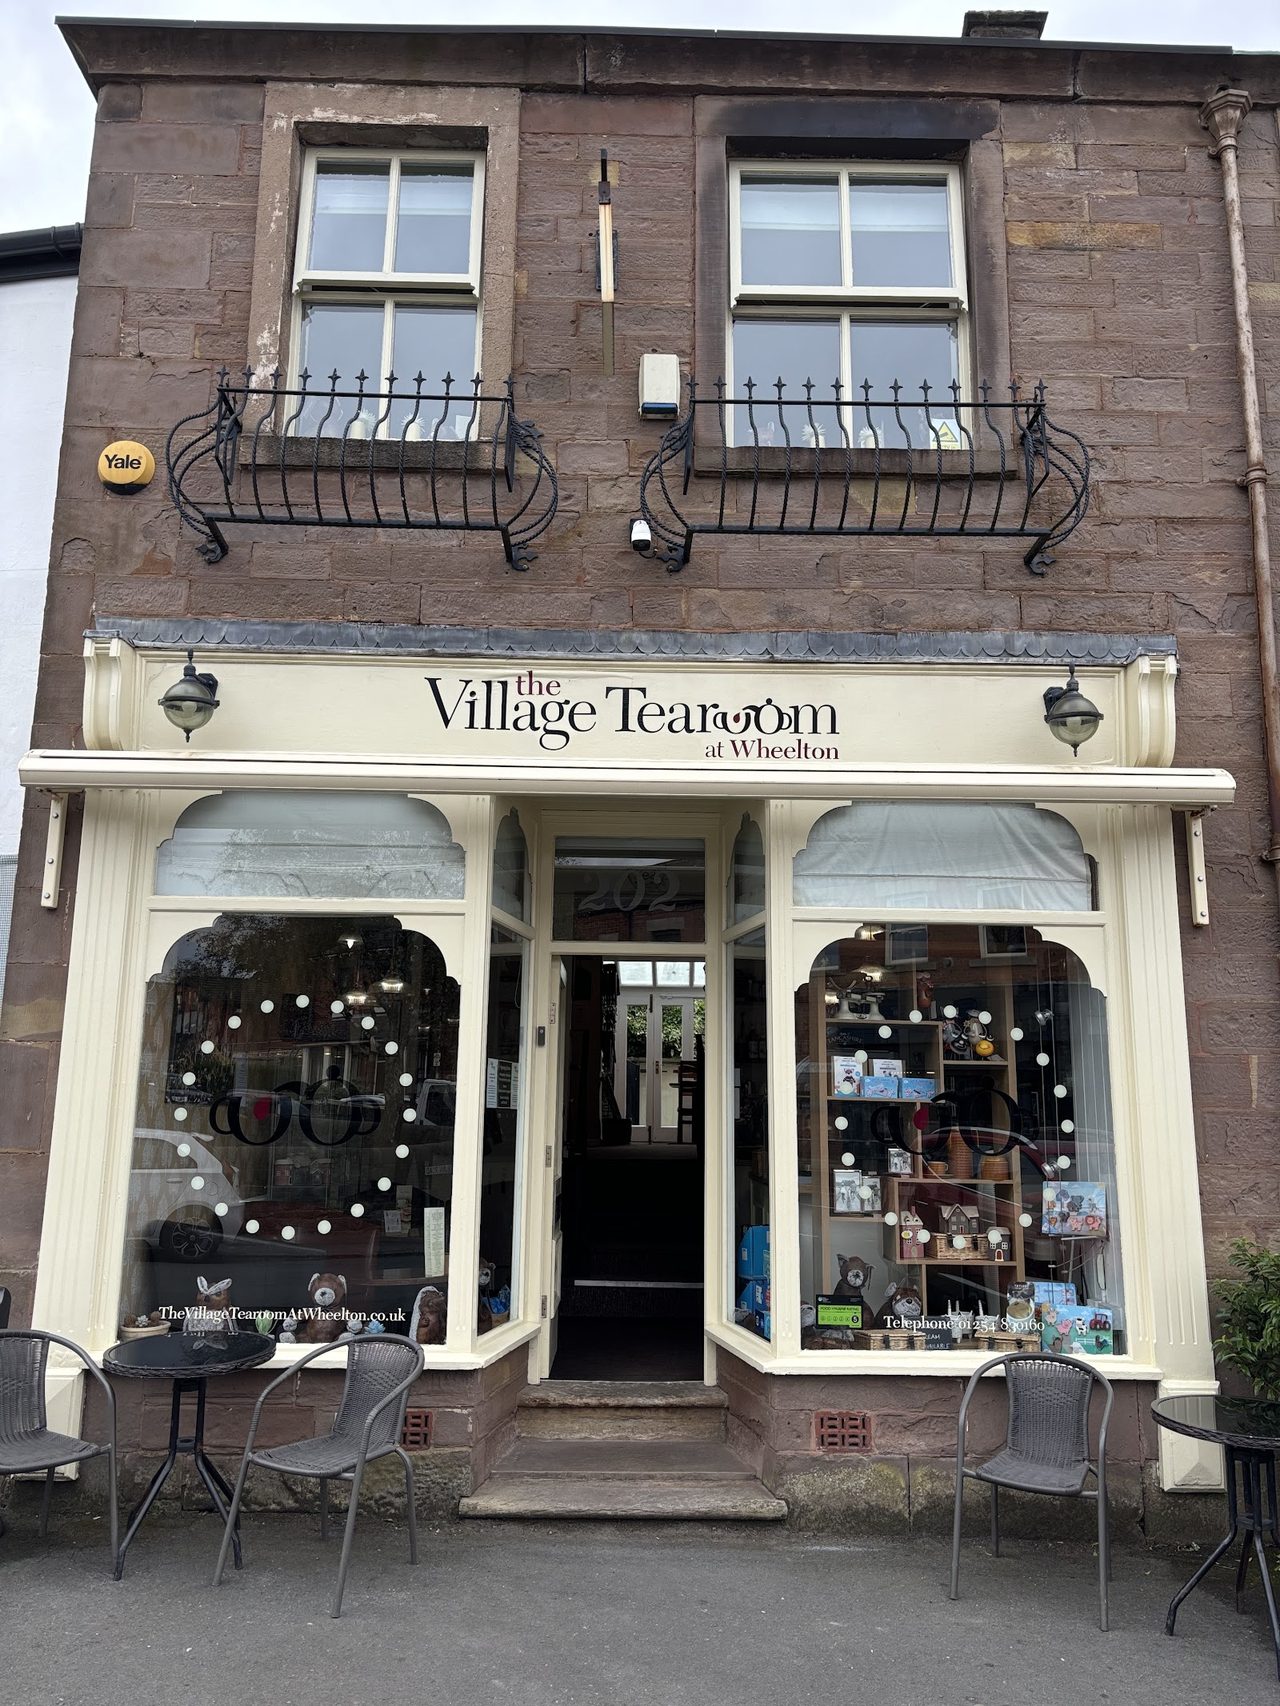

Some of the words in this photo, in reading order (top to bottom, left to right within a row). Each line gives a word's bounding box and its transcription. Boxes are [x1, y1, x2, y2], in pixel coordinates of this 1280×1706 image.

[104, 454, 142, 470] Yale
[515, 670, 561, 696] the
[424, 677, 597, 751] Village
[605, 686, 840, 735] Tearoom
[705, 741, 724, 759] at
[730, 739, 840, 760] Wheelton
[578, 869, 680, 912] 202
[158, 1305, 406, 1323] TheVillageTearoomAtWheelton.co.uk
[883, 1315, 955, 1332] Telephone
[958, 1320, 995, 1333] 01254
[1000, 1317, 1045, 1333] 830160
